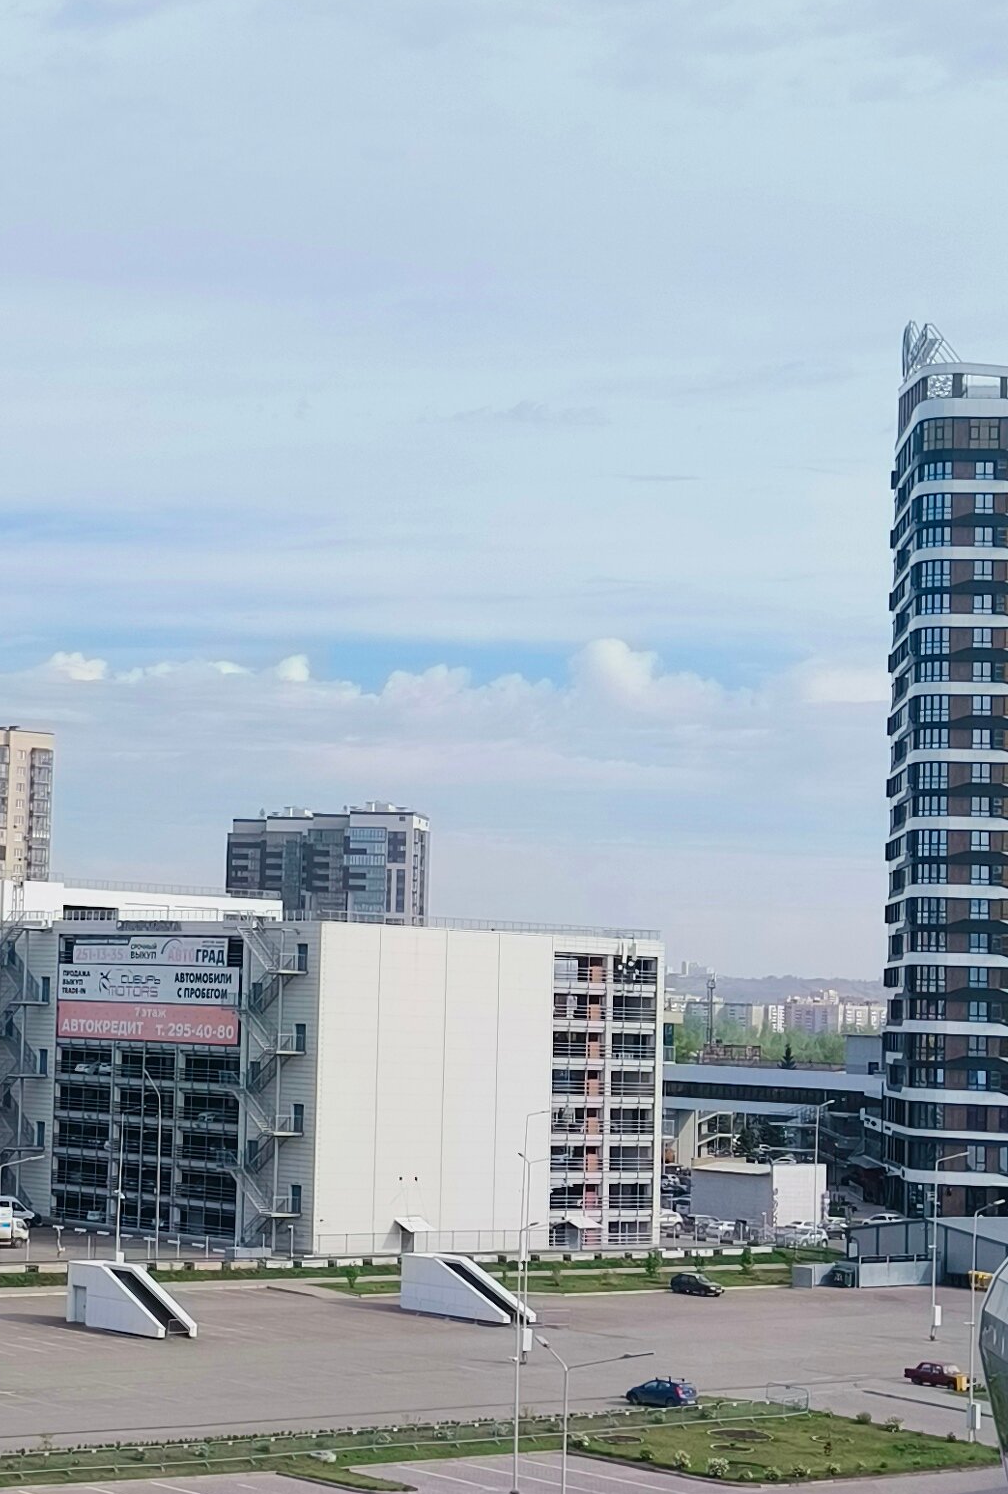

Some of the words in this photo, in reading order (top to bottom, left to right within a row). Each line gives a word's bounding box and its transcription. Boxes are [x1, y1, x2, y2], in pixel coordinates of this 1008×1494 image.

[130, 950, 157, 960] ВЫКУП
[62, 969, 91, 978] ПРОДАЖА
[174, 971, 232, 984] АВТОМОБИЛИ
[62, 987, 87, 995] TRADE-IN
[176, 987, 182, 998] С
[183, 987, 228, 1000] ПРОБЕГОМ
[61, 1018, 144, 1036] АВТОКРЕДИТ
[167, 1023, 234, 1039] 295-40-80
